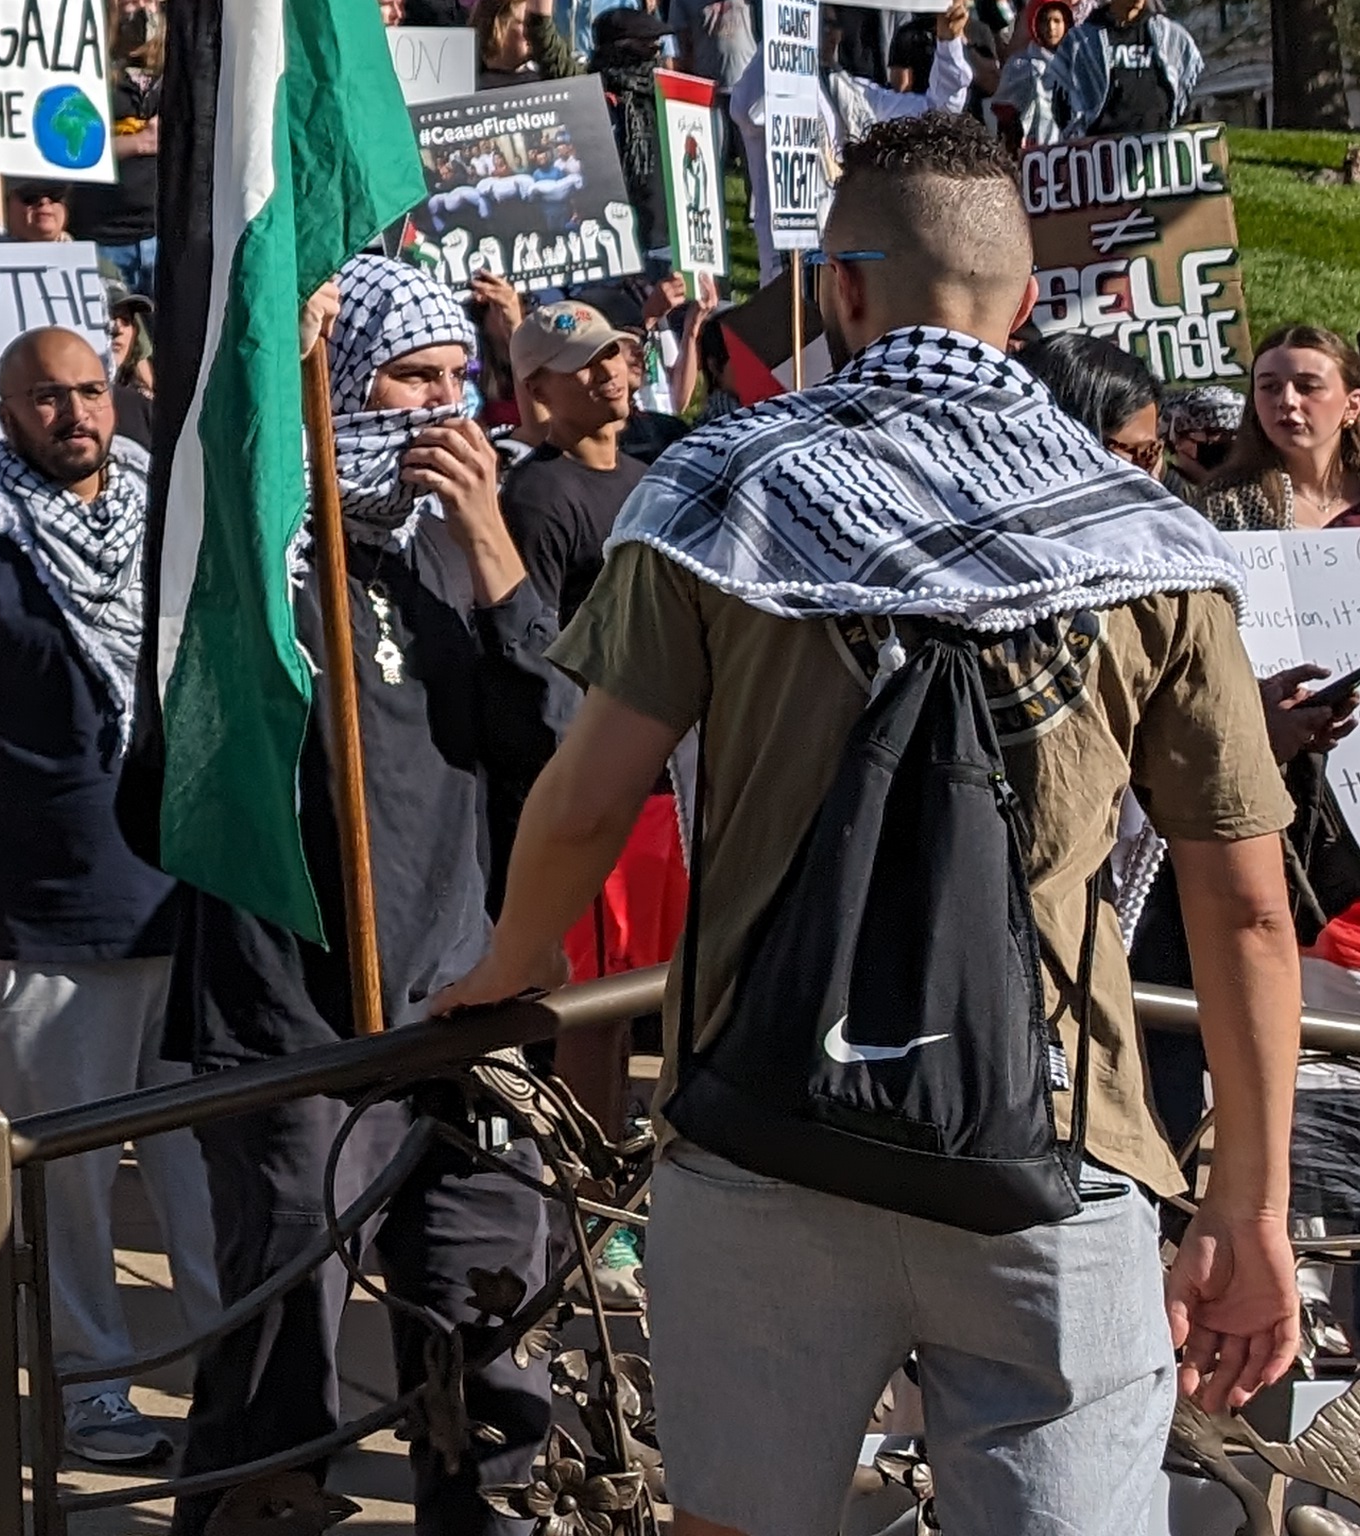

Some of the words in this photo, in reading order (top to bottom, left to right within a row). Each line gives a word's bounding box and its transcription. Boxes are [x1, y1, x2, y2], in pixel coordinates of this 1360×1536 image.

[778, 4, 811, 40] AGAINST
[466, 105, 496, 115] WITH
[503, 92, 569, 110] PALESTINE
[419, 111, 556, 147] #CeaseFireNow
[772, 114, 781, 146] IS
[783, 115, 791, 146] A
[1022, 128, 1224, 213] GENOCIDE
[1033, 249, 1236, 336] SELF
[1293, 541, 1337, 566] it's
